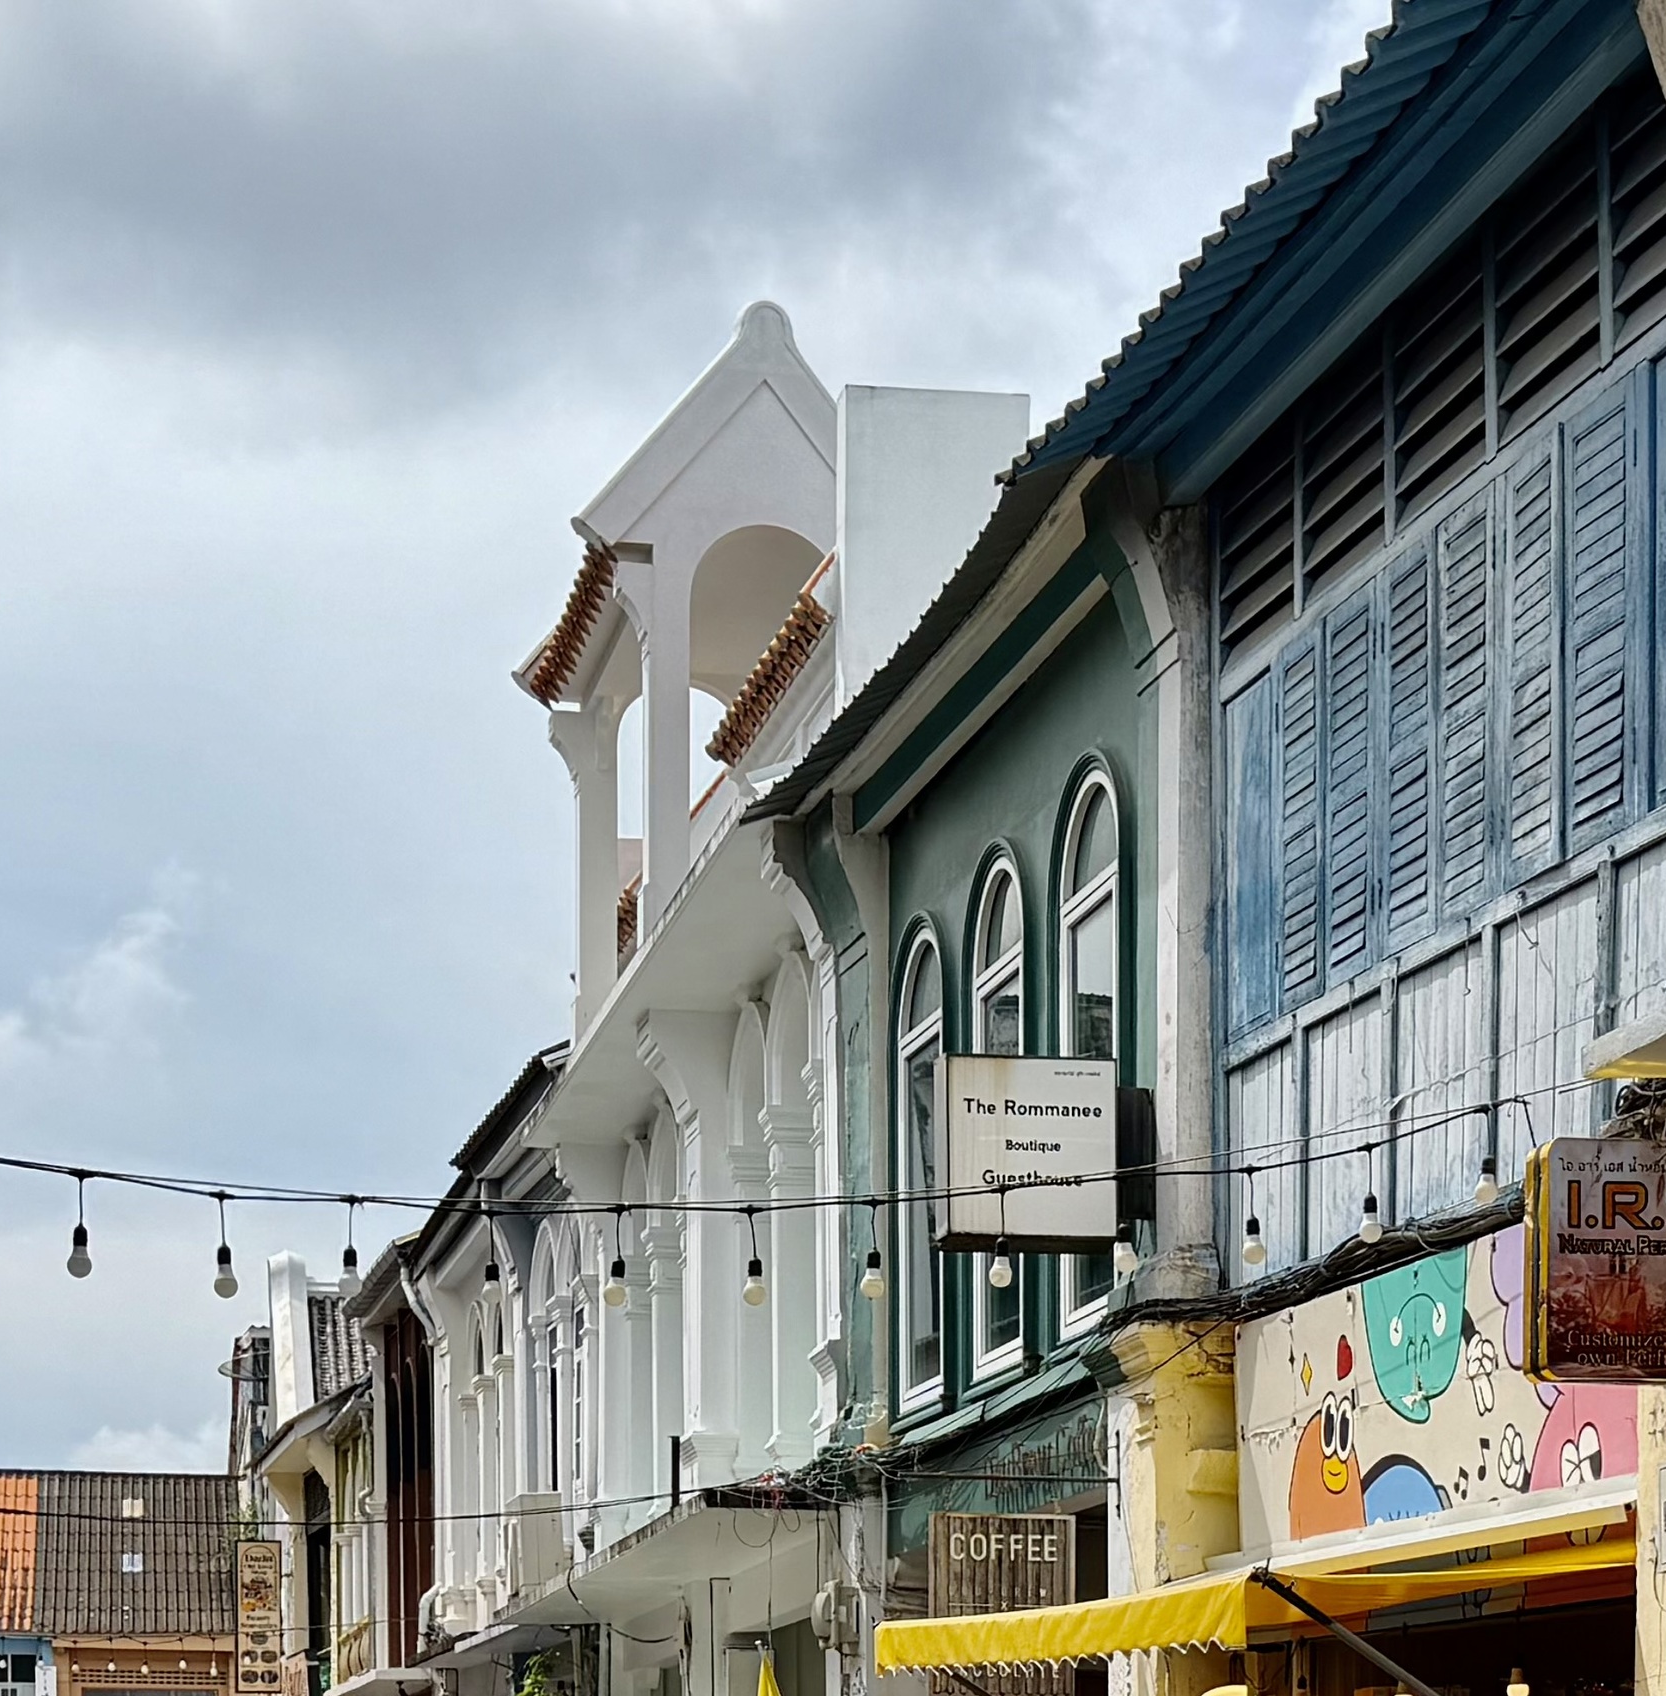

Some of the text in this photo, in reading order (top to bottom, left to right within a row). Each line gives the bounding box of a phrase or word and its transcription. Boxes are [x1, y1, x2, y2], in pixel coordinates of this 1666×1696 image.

[963, 1098, 1103, 1118] The Rommanee
[1005, 1139, 1062, 1154] Boutique
[1577, 1350, 1617, 1367] own
[949, 1533, 1059, 1562] COFFEE
